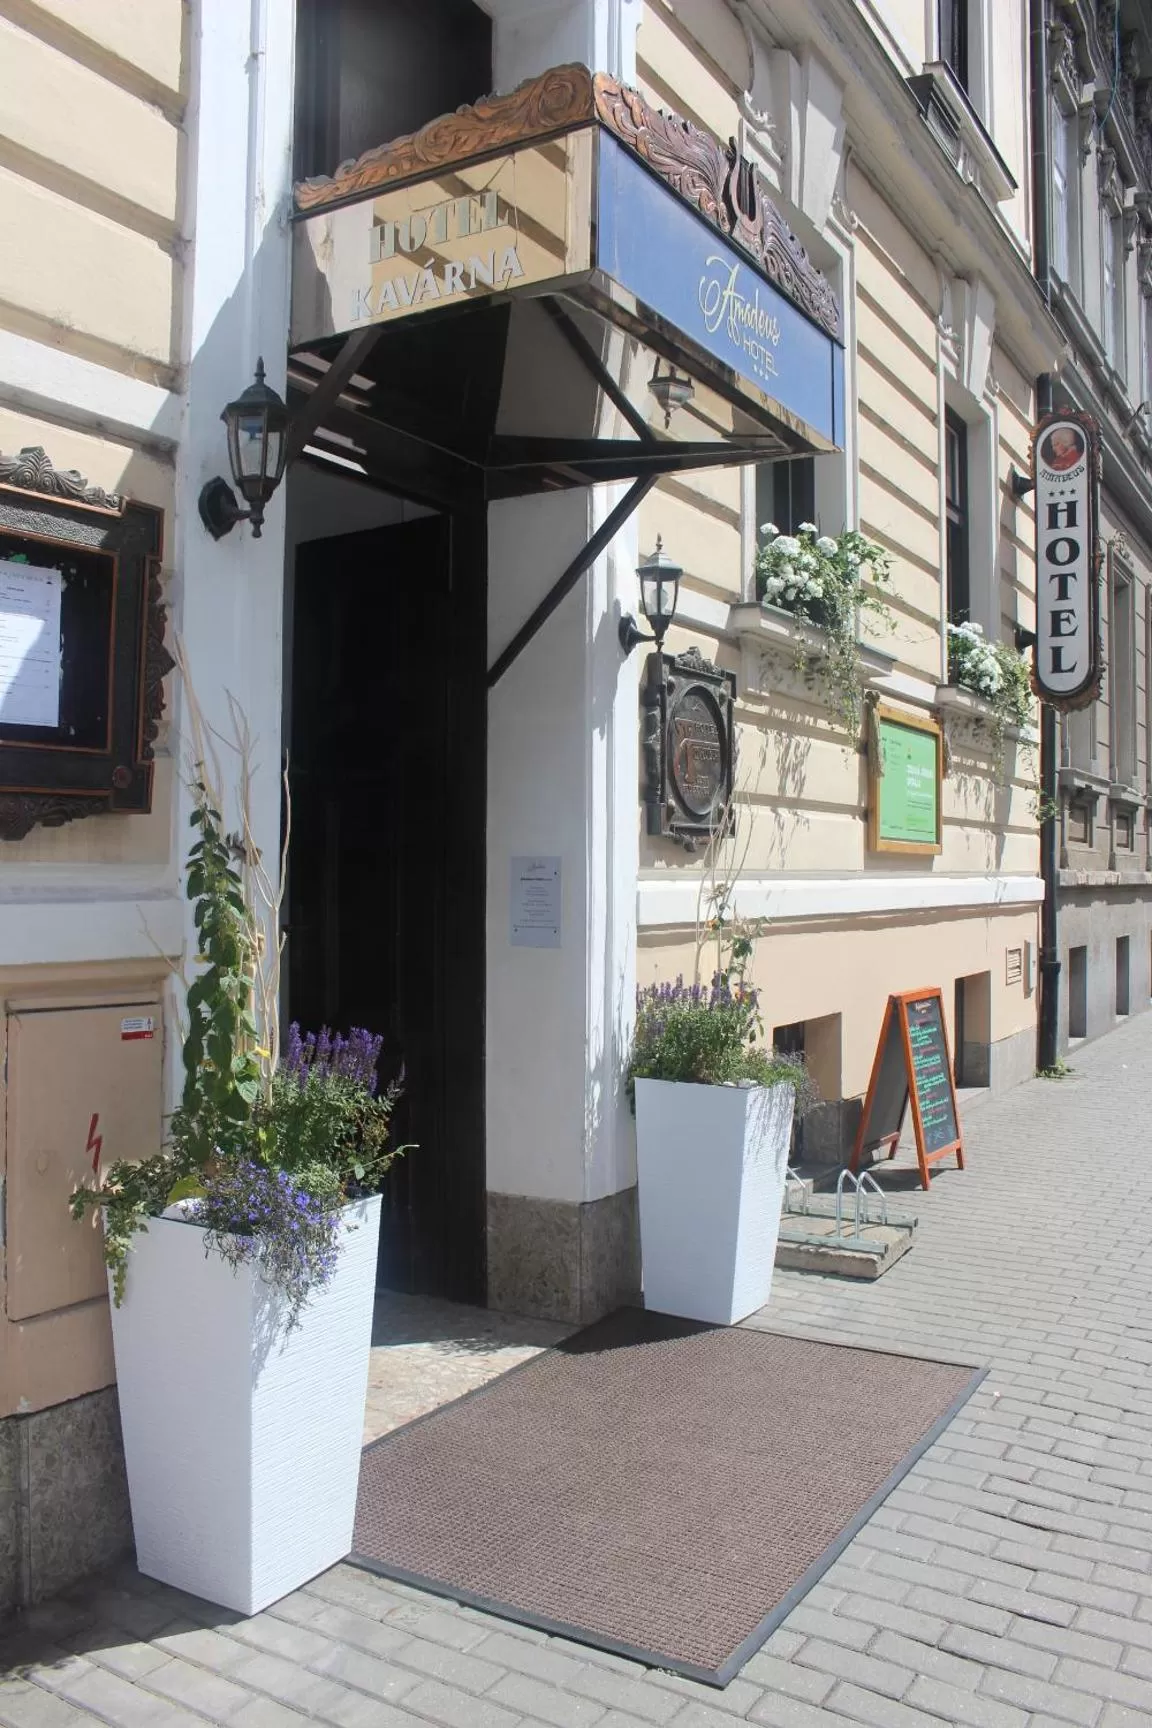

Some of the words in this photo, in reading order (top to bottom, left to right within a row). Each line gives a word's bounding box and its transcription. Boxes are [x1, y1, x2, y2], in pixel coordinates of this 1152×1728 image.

[368, 191, 510, 265] HOTEL
[350, 245, 526, 322] KAVÁRNA
[698, 255, 781, 347] Amadeus
[743, 333, 778, 377] HOTEL
[1045, 499, 1080, 676] HOTEL
